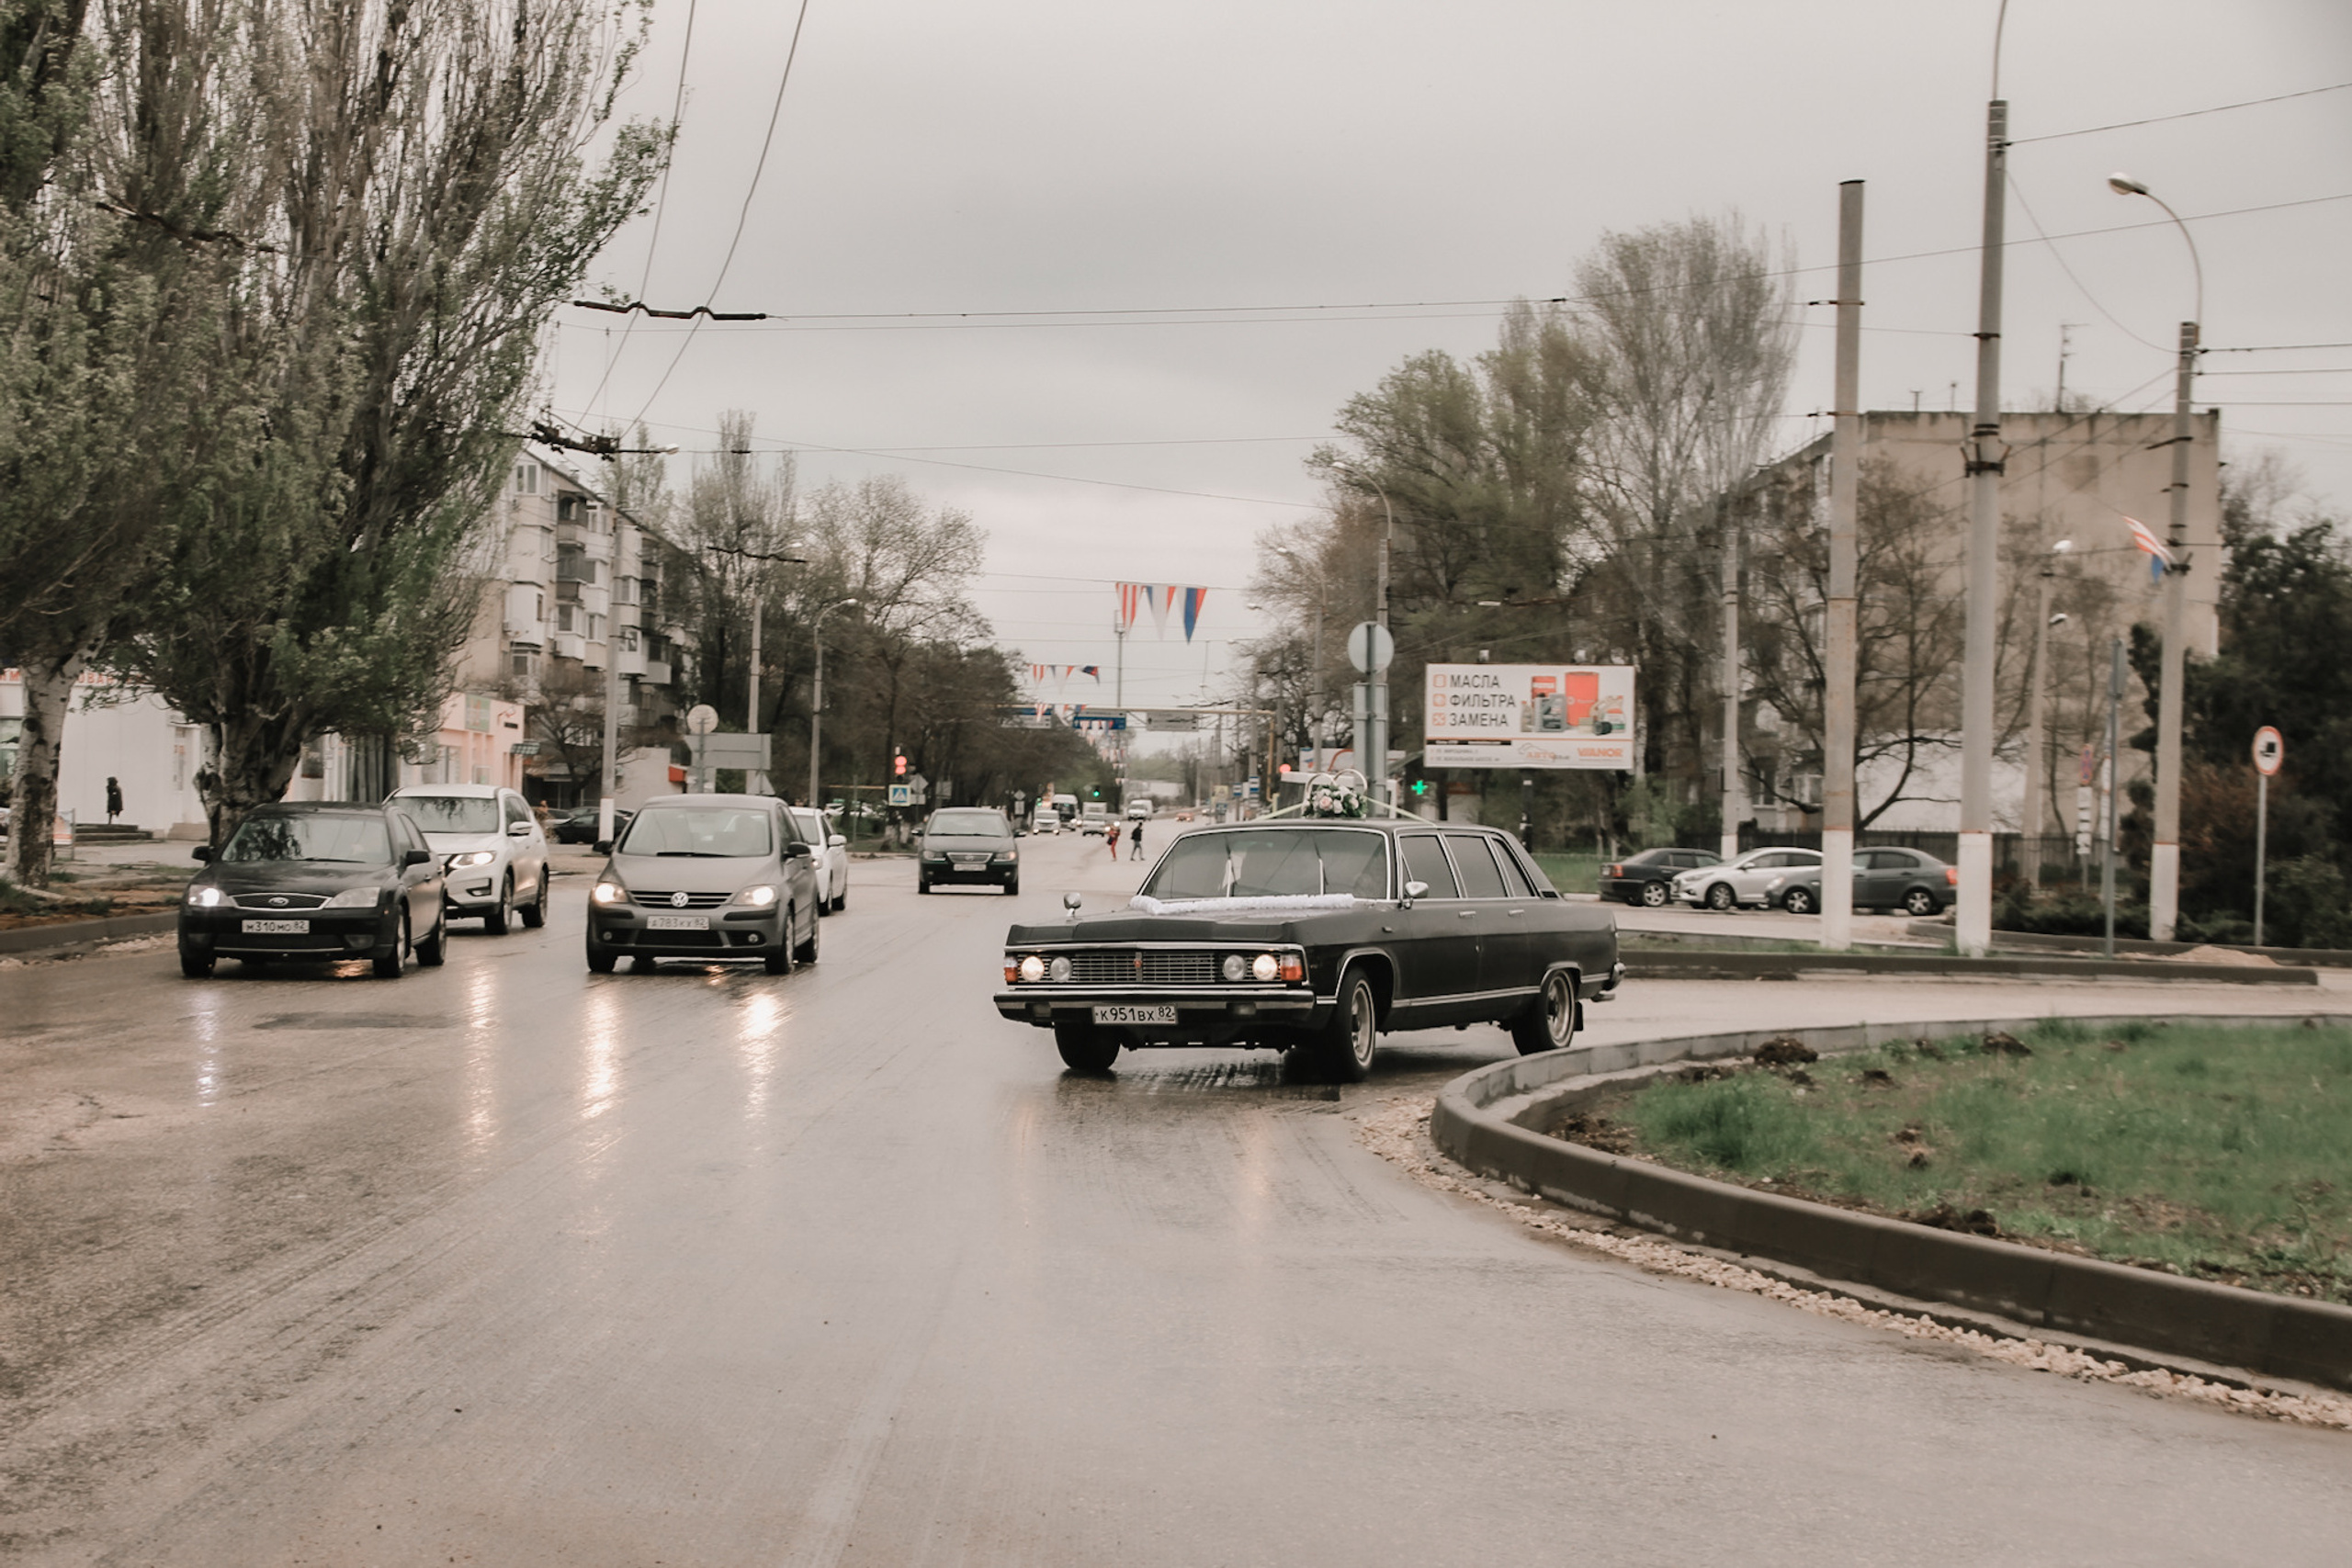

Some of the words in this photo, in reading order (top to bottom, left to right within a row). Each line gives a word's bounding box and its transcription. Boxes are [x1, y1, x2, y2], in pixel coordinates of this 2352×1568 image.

[1450, 674, 1500, 688] МАСЛА
[1450, 694, 1516, 707] ФИЛЬТРА
[1450, 713, 1509, 727] ЗАМЕНА
[1101, 1007, 1155, 1021] К951ВХ
